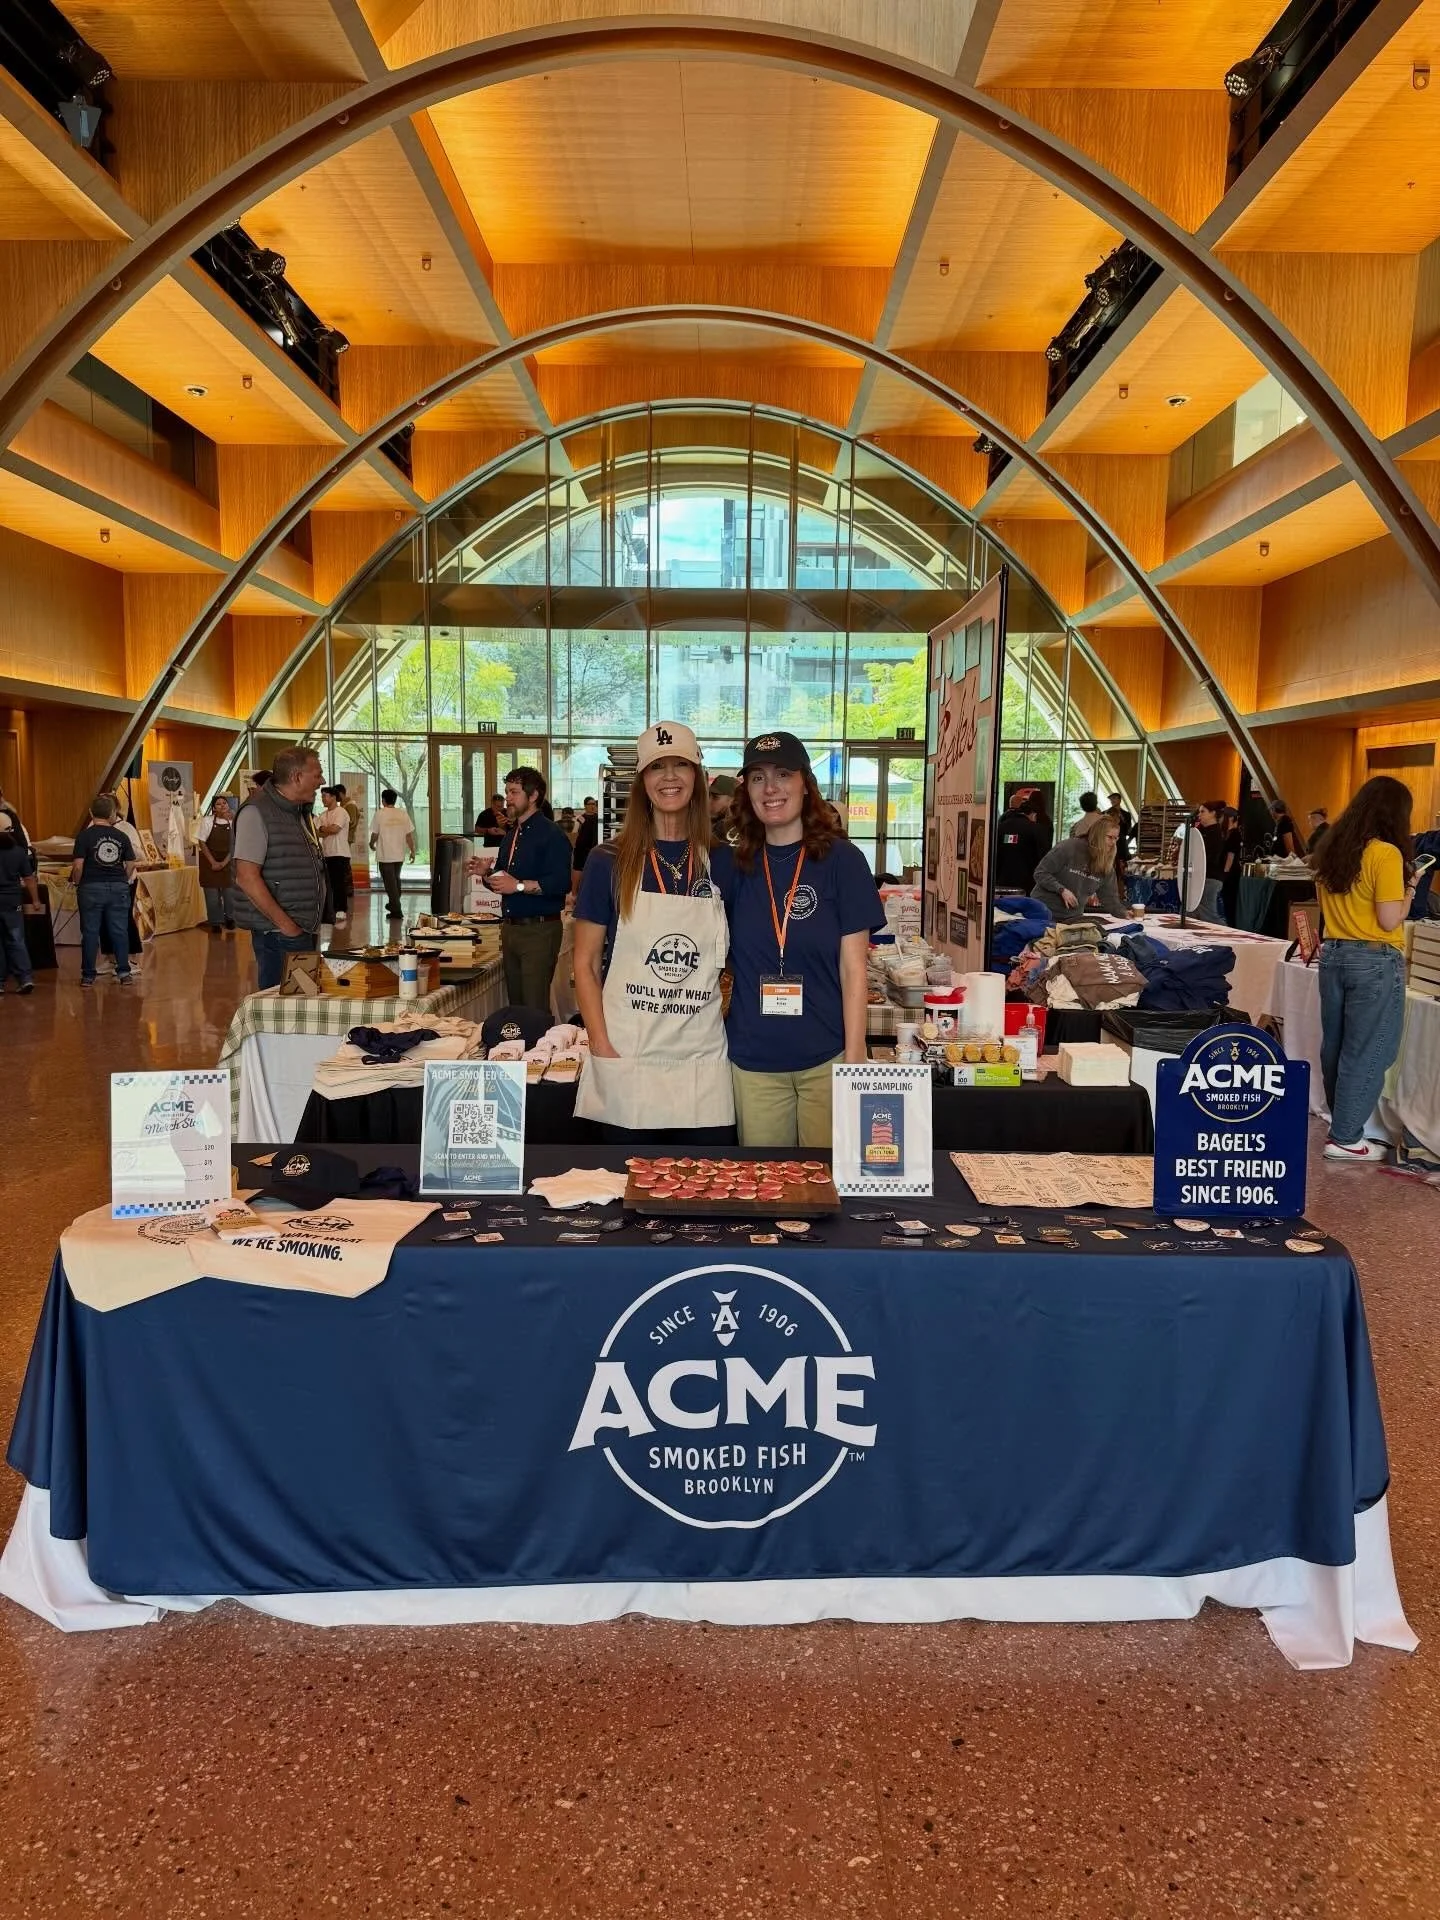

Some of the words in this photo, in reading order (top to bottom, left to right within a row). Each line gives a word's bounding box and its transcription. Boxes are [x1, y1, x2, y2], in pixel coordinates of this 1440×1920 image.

[656, 726, 673, 746] LA
[900, 729, 913, 739] EXIT
[644, 948, 701, 970] ACME
[626, 982, 656, 998] YOU'LL
[659, 988, 683, 999] WANT
[685, 988, 712, 1001] WHAT
[631, 999, 660, 1014] WE'RE
[500, 1027, 521, 1035] ACME
[1208, 1046, 1224, 1059] SINCE
[1246, 1046, 1259, 1058] 1906
[431, 1069, 457, 1080] ACME
[459, 1069, 497, 1080] SMOED
[1179, 1063, 1286, 1097] ACME
[851, 1082, 871, 1091] NOW
[873, 1082, 913, 1091] SAMPLING
[1206, 1093, 1240, 1102] SMOKED
[1243, 1093, 1261, 1102] FISH
[148, 1100, 195, 1117] ACME
[1217, 1103, 1249, 1111] BROOKLYN
[1197, 1133, 1266, 1152] BAGEL'S
[280, 1162, 311, 1172] ACME
[1175, 1159, 1218, 1177] BEST
[1224, 1160, 1286, 1178] FRIEND
[463, 1174, 483, 1182] ACME
[1181, 1185, 1231, 1204] SINCE
[1236, 1186, 1279, 1205] 1906.
[281, 1218, 355, 1230] ACME
[281, 1232, 322, 1240] WANT
[323, 1236, 365, 1244] WHAT
[276, 1240, 343, 1261] SMOKING.
[649, 1305, 696, 1345] SINCE
[758, 1303, 798, 1337] 1906
[567, 1355, 878, 1452] ACME
[649, 1444, 746, 1471] SMOKED
[757, 1442, 806, 1469] FISH
[848, 1451, 865, 1463] TM
[684, 1476, 774, 1495] BROOKLYN
